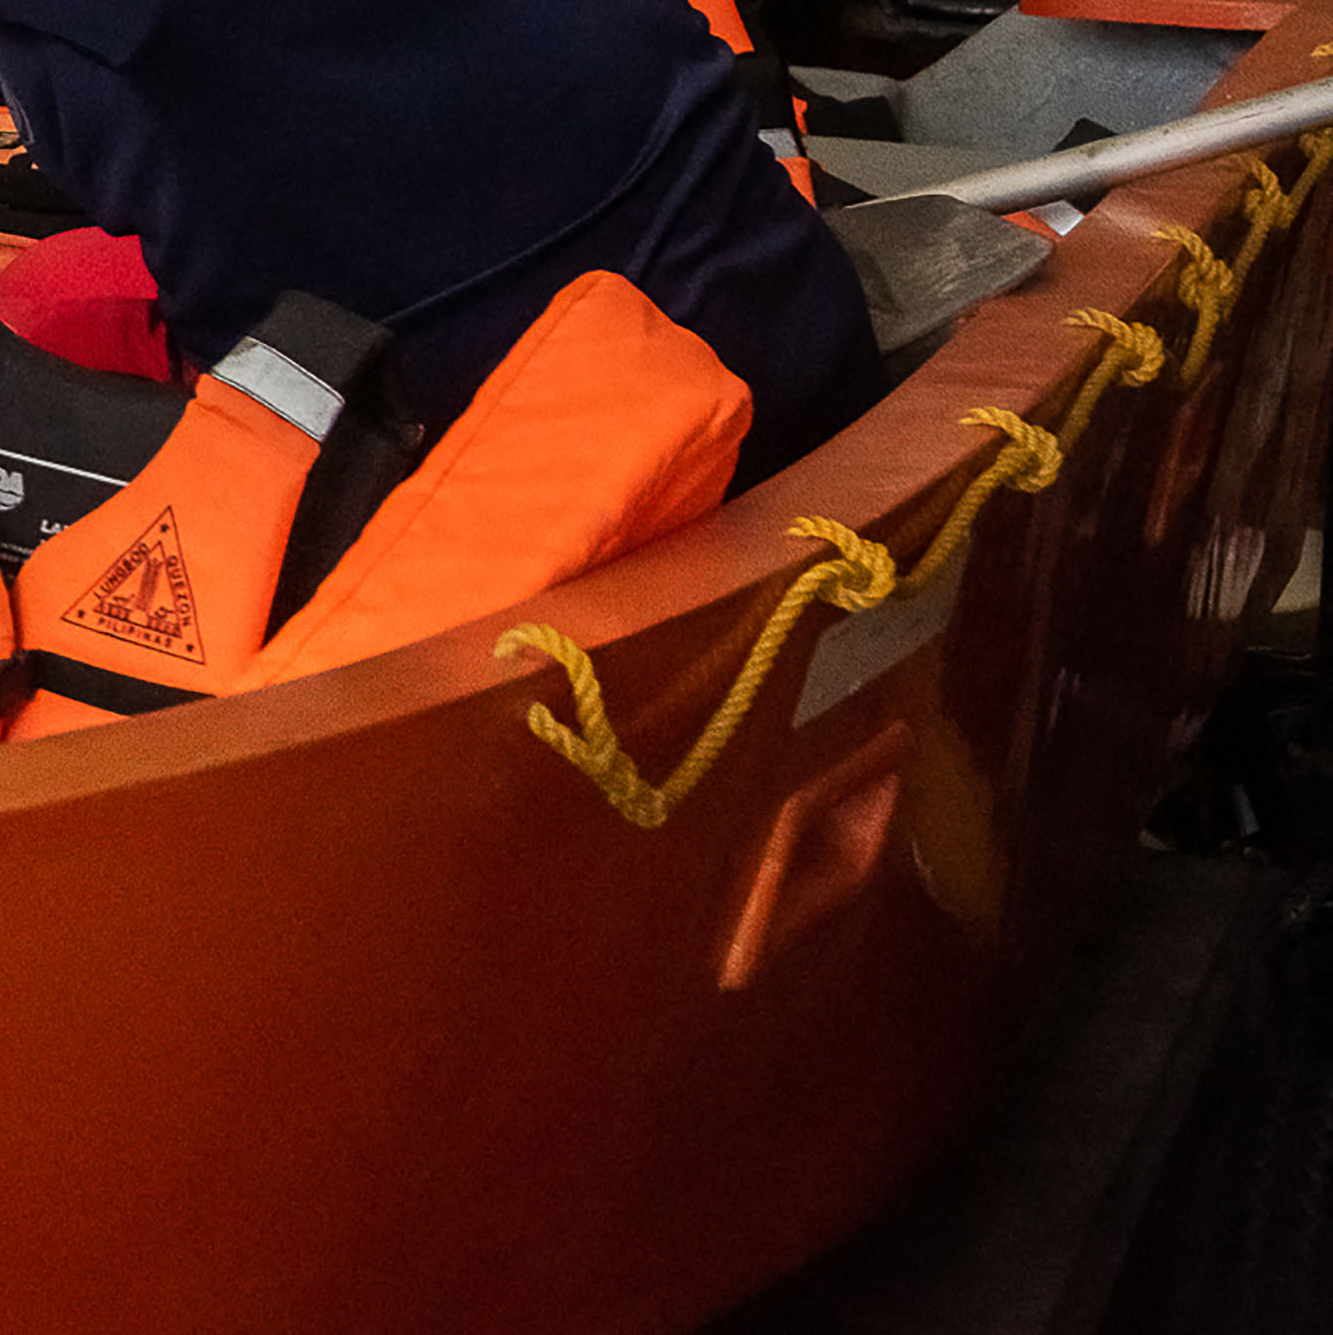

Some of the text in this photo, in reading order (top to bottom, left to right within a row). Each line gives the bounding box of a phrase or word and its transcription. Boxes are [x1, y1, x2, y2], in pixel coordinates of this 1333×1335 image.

[93, 542, 150, 601] LUNGSOD
[165, 555, 191, 627] QUEZON
[98, 617, 172, 649] PILIPINAS
